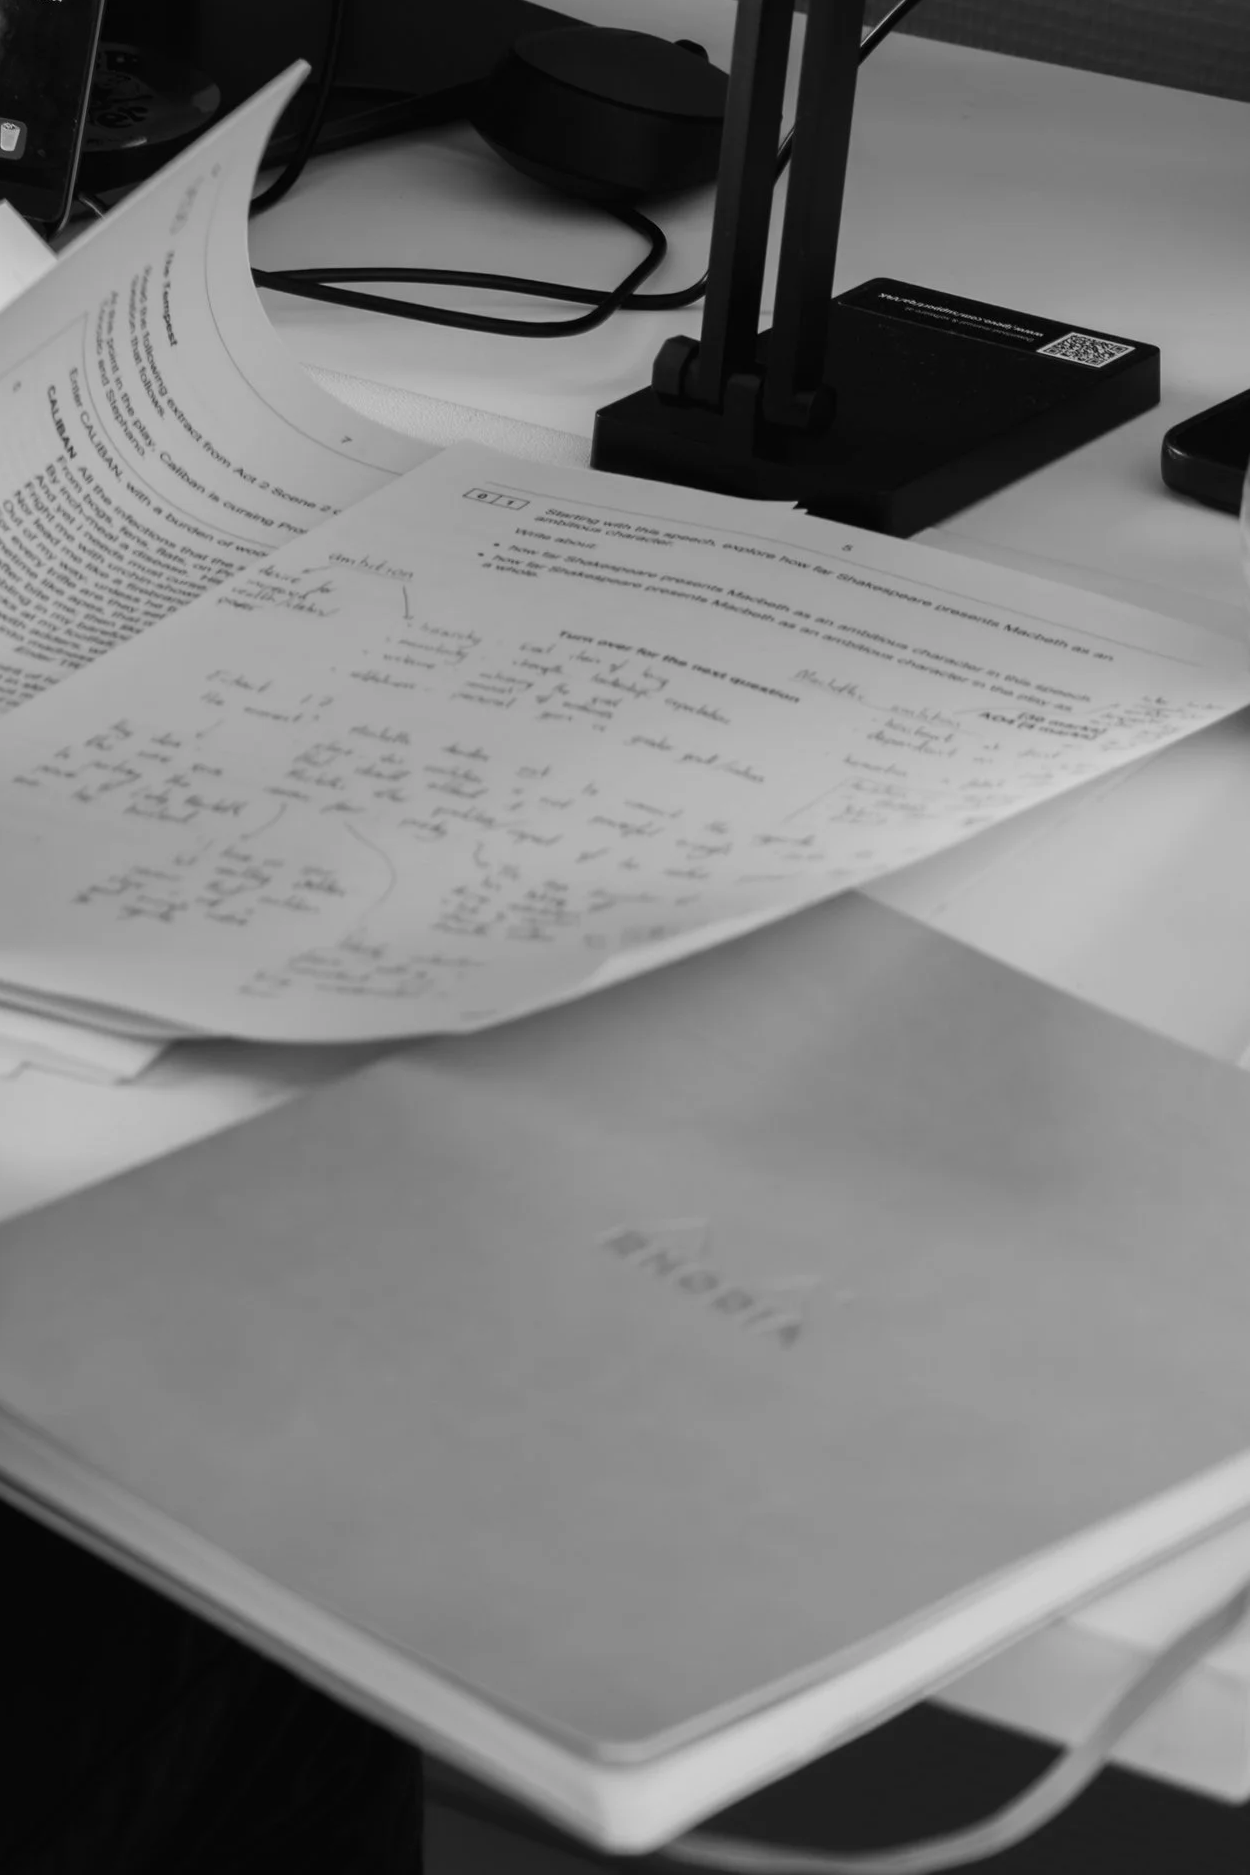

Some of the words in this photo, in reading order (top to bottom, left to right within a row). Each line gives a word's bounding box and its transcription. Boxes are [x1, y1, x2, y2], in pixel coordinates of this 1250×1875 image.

[162, 281, 178, 347] Tempest
[47, 385, 77, 460] CALIBAN
[166, 397, 203, 444] extract
